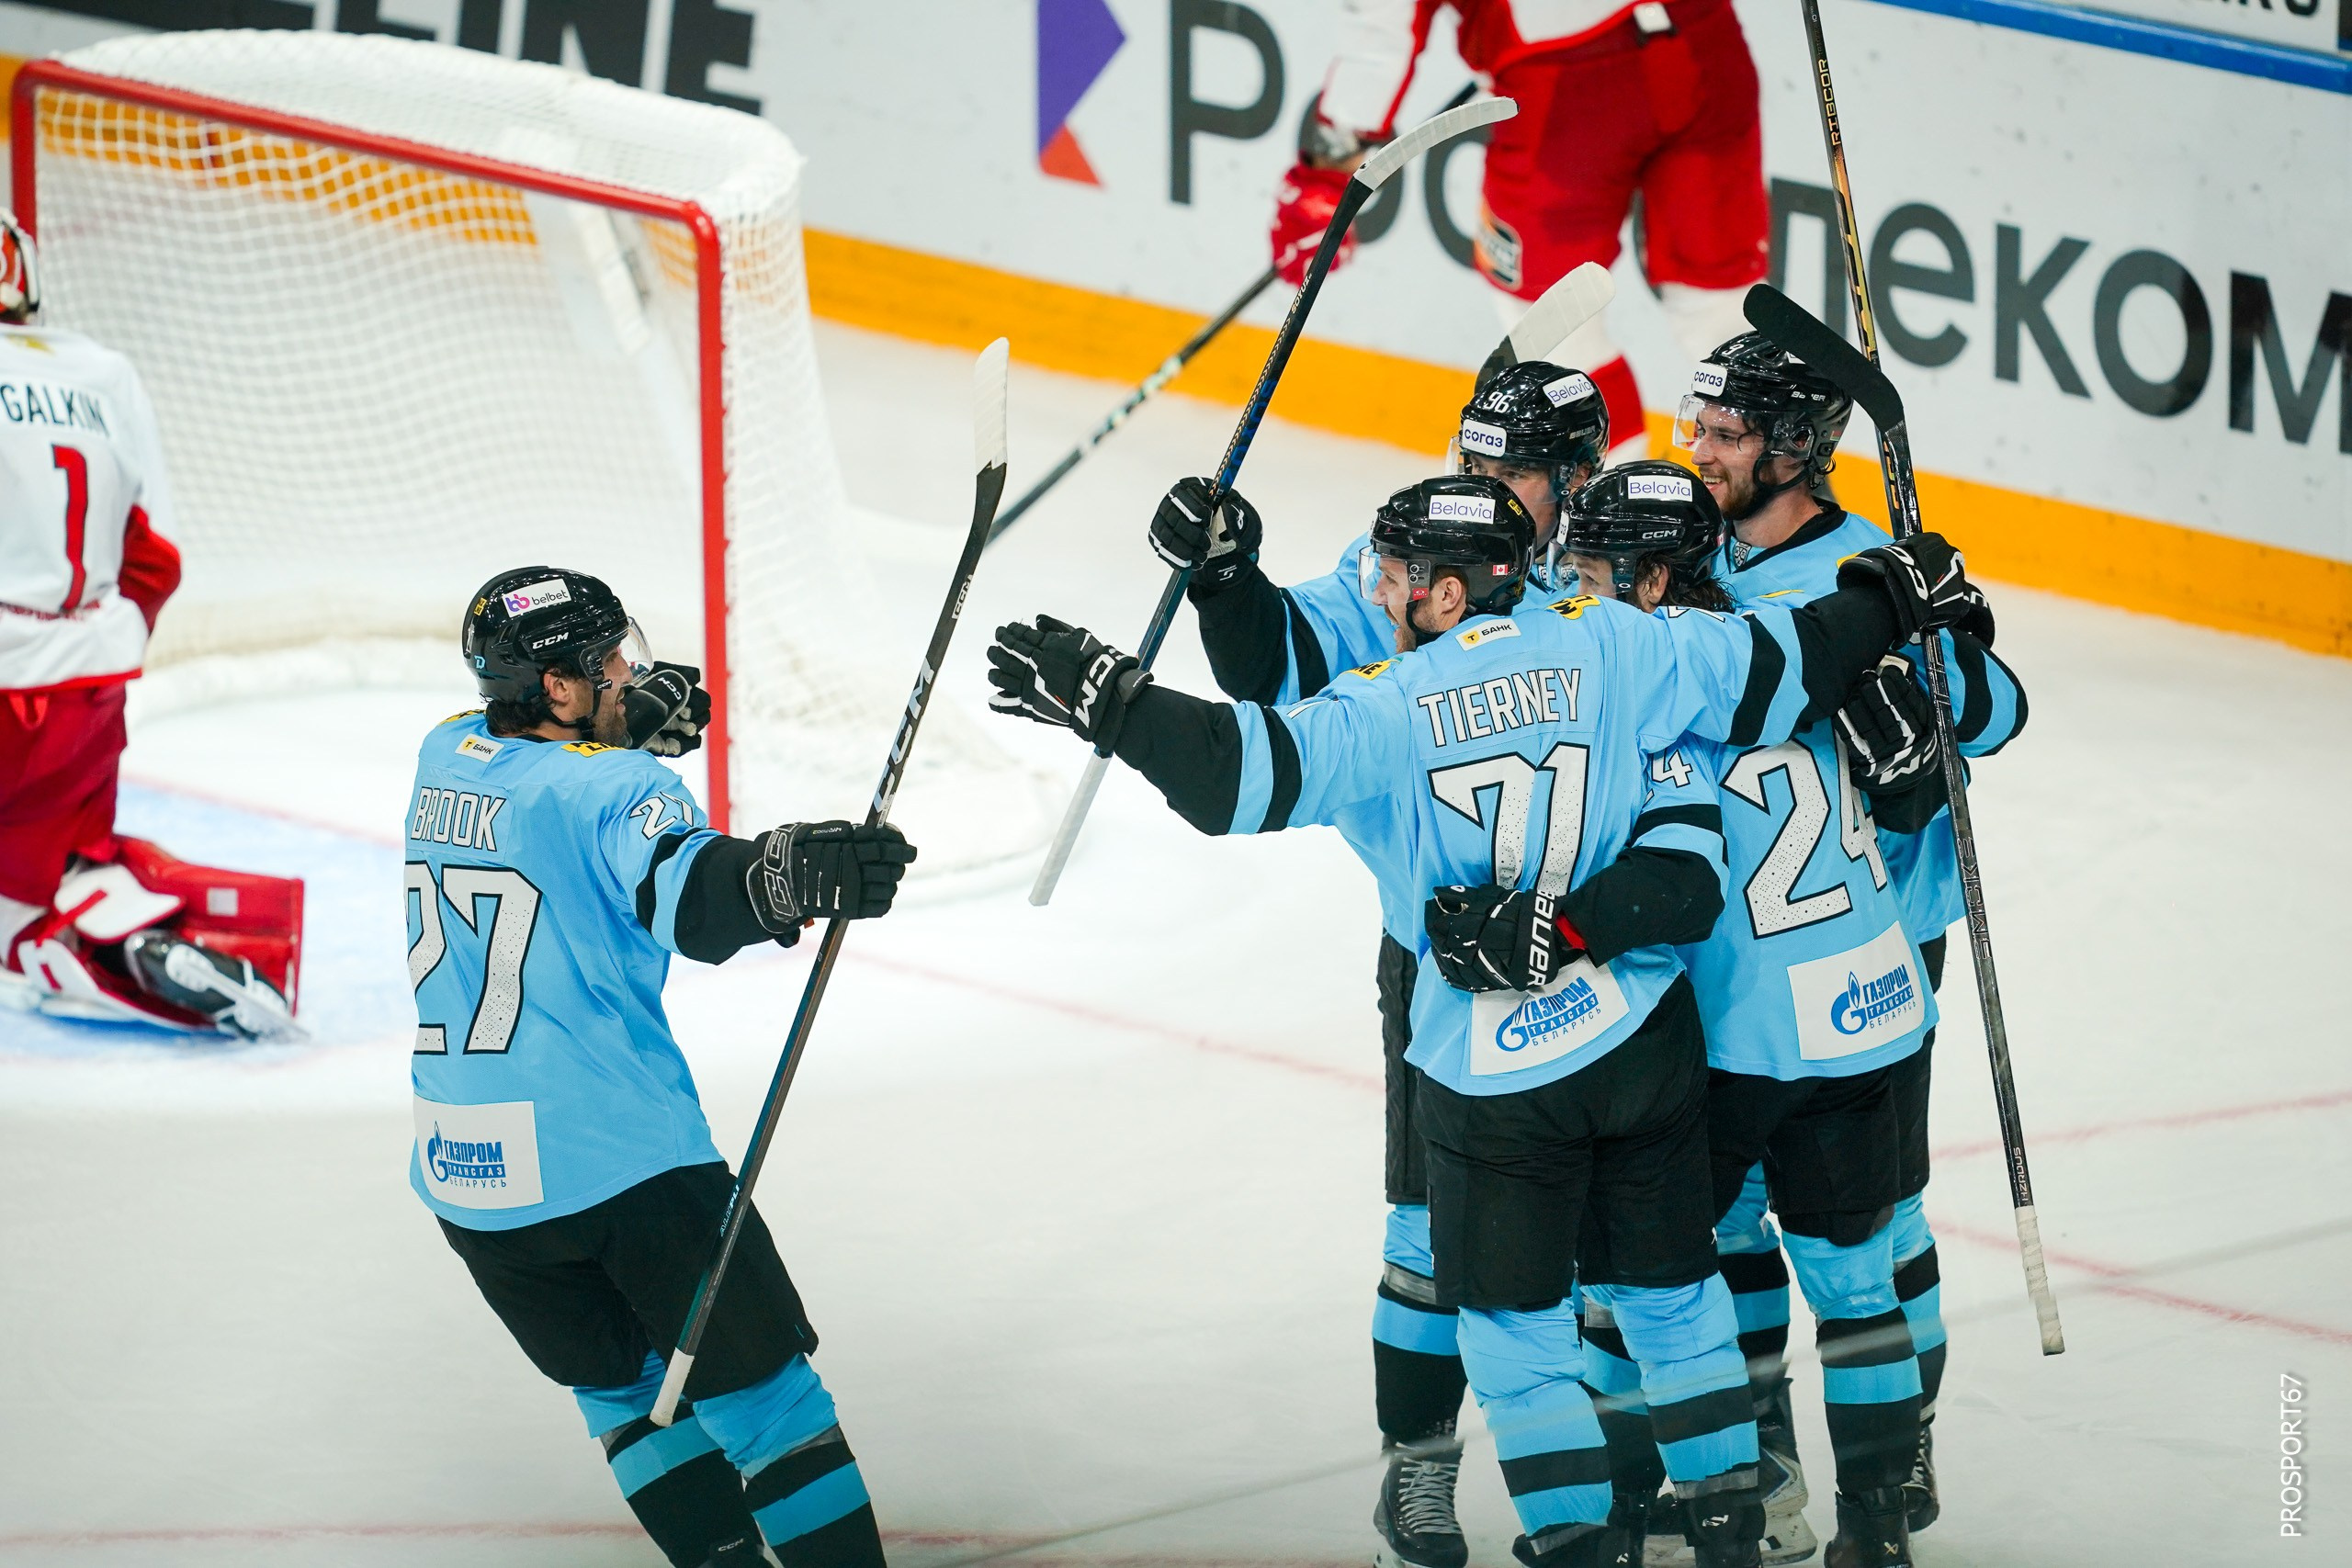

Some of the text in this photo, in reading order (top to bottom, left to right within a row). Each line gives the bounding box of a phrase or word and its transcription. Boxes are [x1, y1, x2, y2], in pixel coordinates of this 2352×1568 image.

[1818, 59, 1841, 145] RIBCOR
[1693, 369, 1724, 388] согаз
[0, 384, 109, 430] GALKIN
[1483, 391, 1514, 414] 96
[1464, 428, 1503, 448] согаз
[1630, 480, 1691, 497] Belavia
[1430, 501, 1494, 520] Belavia
[51, 444, 88, 614] 1
[1641, 528, 1678, 540] CCM
[532, 589, 569, 606] belbet
[532, 631, 570, 650] CCM
[1481, 624, 1512, 637] БАНК
[658, 677, 682, 700] CCM
[1417, 668, 1581, 748] TIERNEY
[472, 743, 494, 755] БАНК
[411, 786, 506, 852] BROOK
[1427, 740, 1591, 897] 71
[1719, 737, 1887, 941] 24
[403, 860, 543, 1055] 27
[1862, 964, 1910, 1005] ГАЗПРОМ
[1524, 976, 1593, 1023] ГАЗПРОМ
[1530, 995, 1598, 1036] ТРАНСГАЗ
[1869, 999, 1917, 1029] БЕЛАРУСЬ
[1532, 1007, 1601, 1046] БЕЛАРУСЬ
[444, 1140, 503, 1164] ГАЗПРОМ
[448, 1164, 504, 1178] ТРАНСГАЗ
[449, 1178, 507, 1189] БЕЛАРУСЬ
[718, 1539, 745, 1552] CCM
